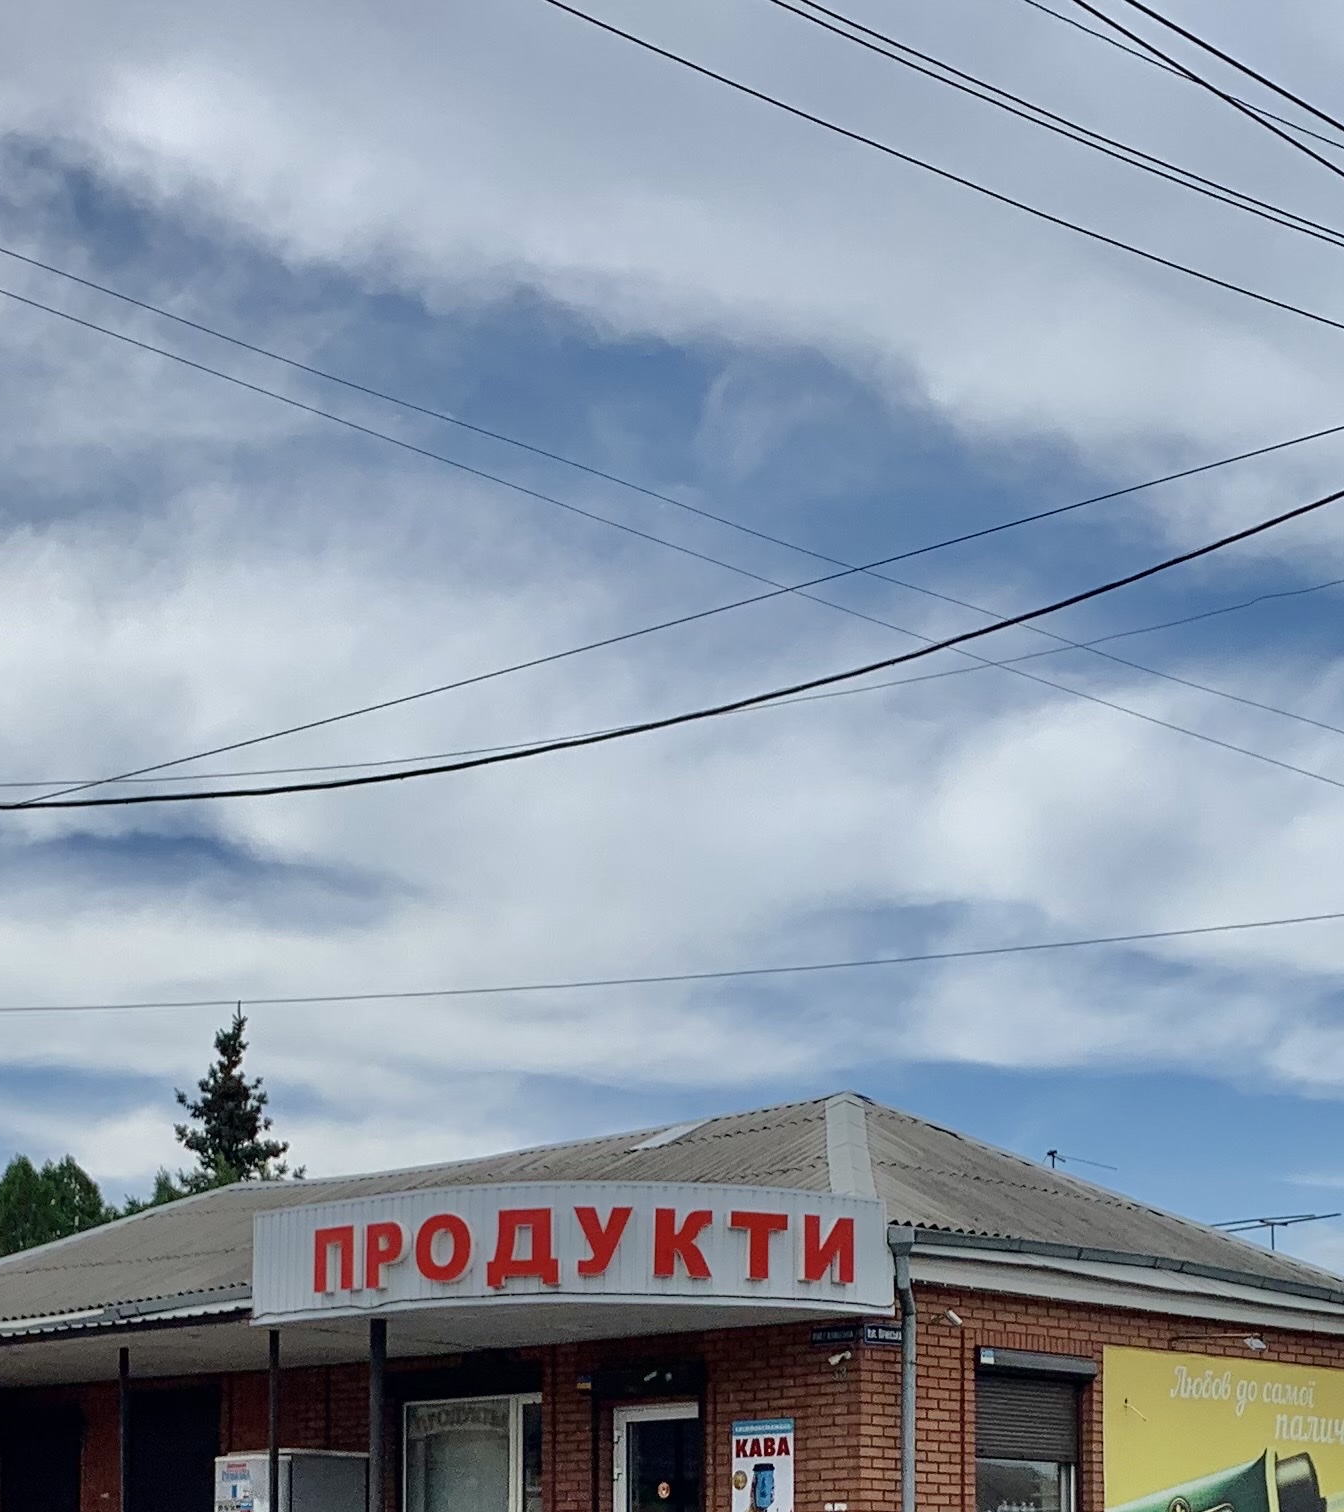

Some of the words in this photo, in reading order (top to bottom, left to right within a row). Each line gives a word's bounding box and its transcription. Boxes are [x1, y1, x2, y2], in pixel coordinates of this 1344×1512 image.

[312, 1204, 856, 1295] ПРОДУКТИ
[1170, 1365, 1232, 1399] Любов
[1235, 1379, 1258, 1417] до
[1262, 1379, 1317, 1409] самої
[735, 1435, 791, 1459] КАВА
